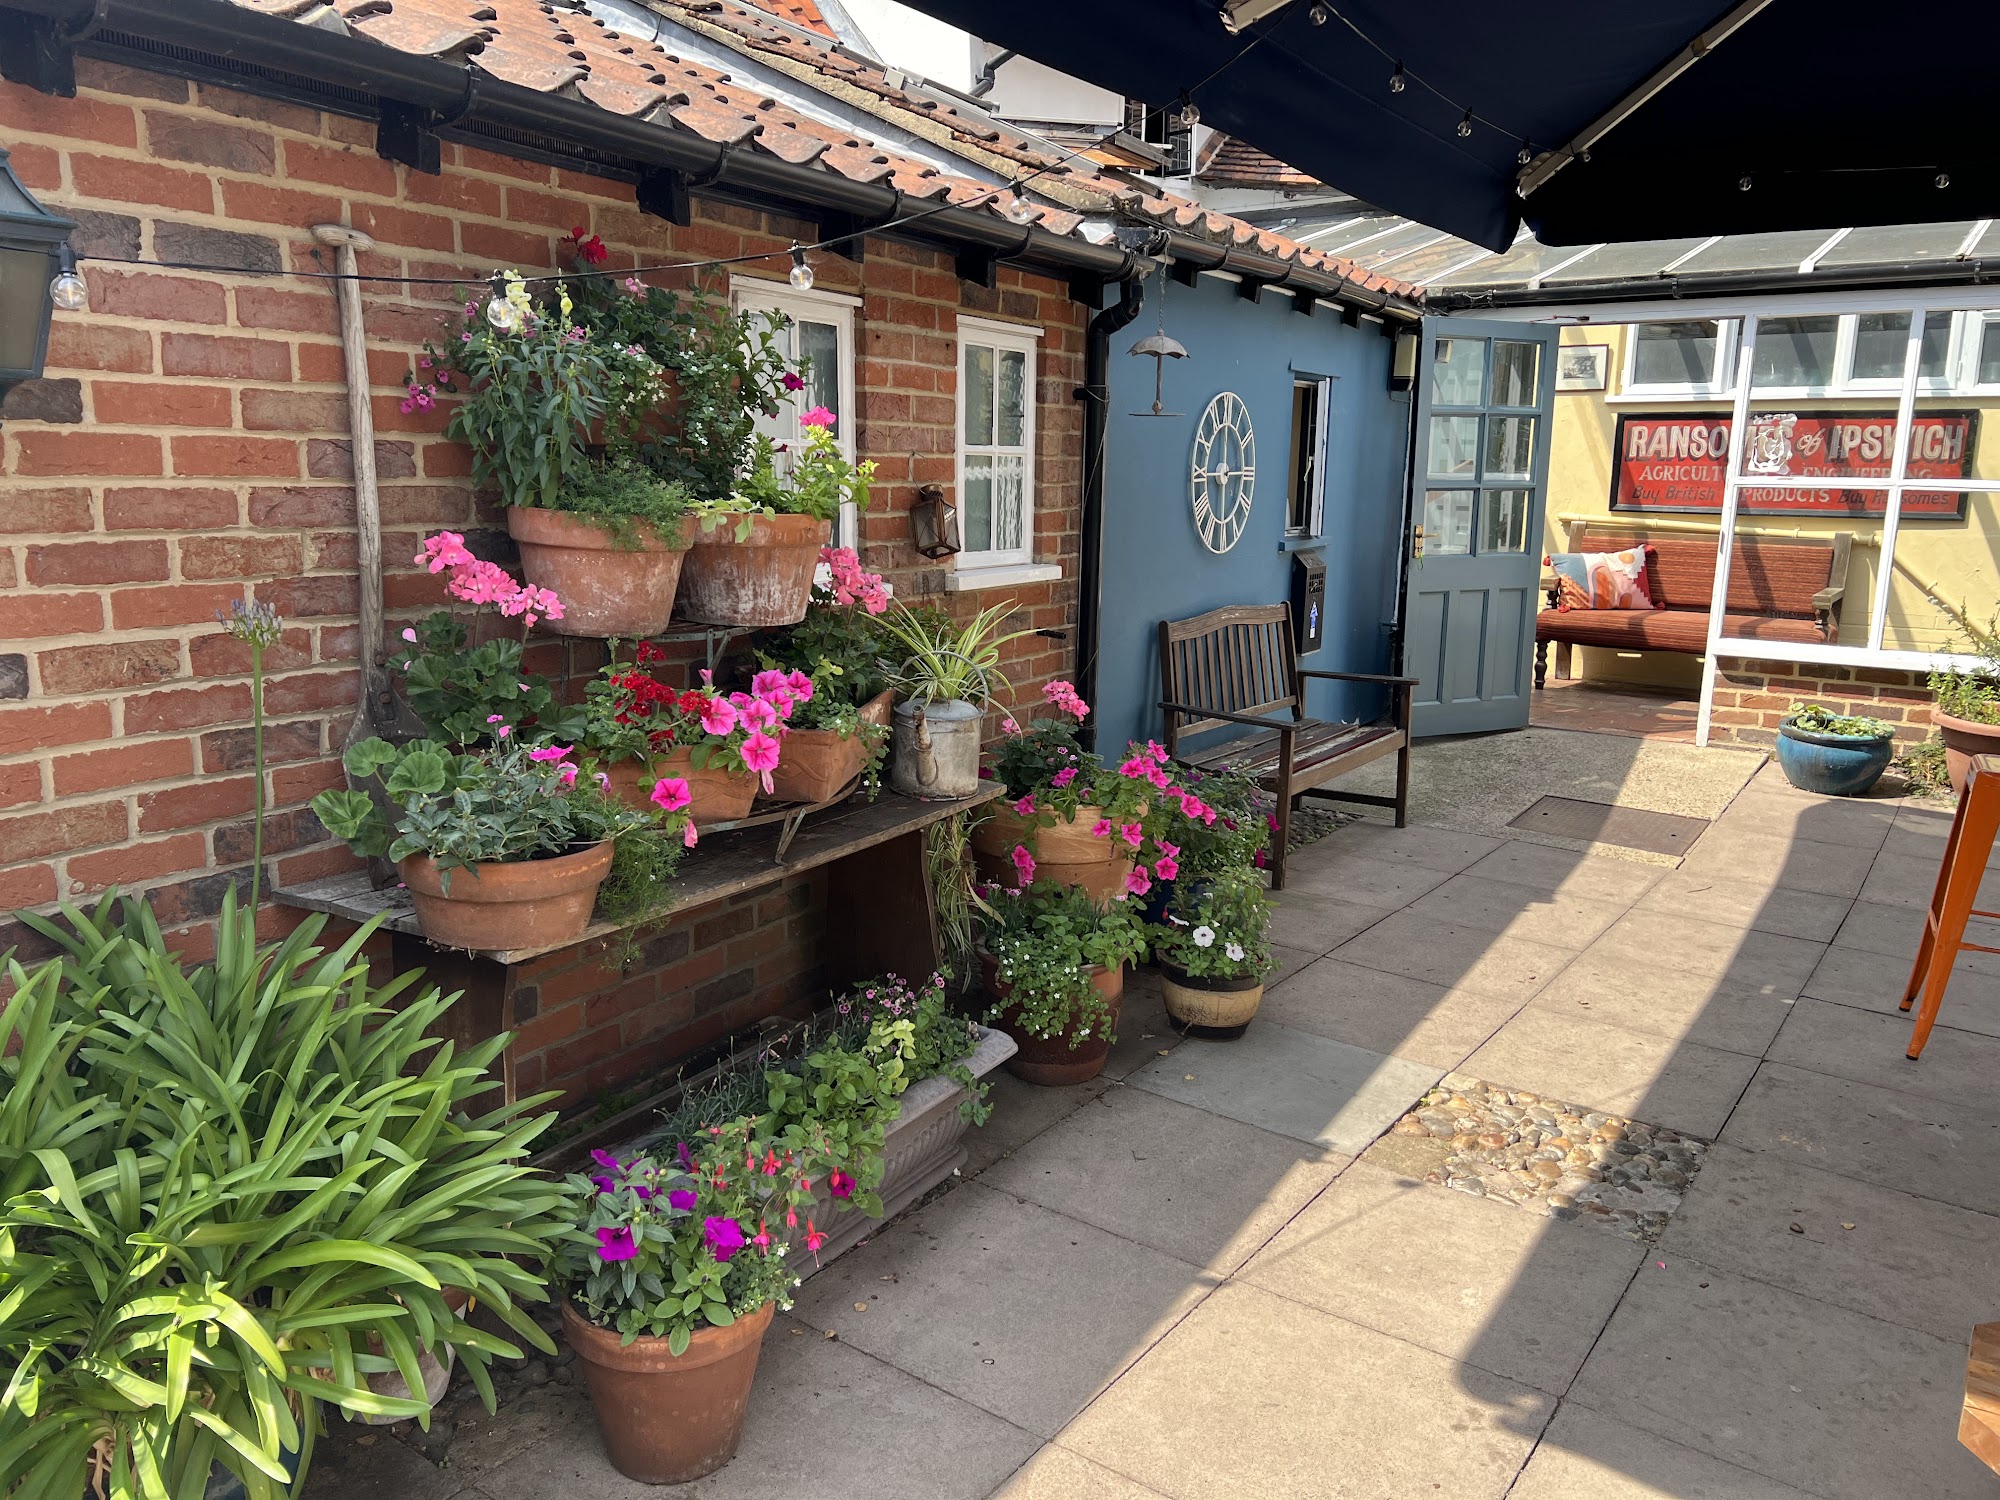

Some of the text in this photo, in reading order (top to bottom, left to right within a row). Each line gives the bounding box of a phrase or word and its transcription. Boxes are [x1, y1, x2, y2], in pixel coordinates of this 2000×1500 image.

[1796, 428, 1826, 457] of
[1803, 467, 1934, 479] ENGINEERNG
[1632, 485, 1715, 504] Buy British
[1741, 488, 1830, 503] PRODUCTS
[1838, 489, 1949, 506] Buy Rasomes
